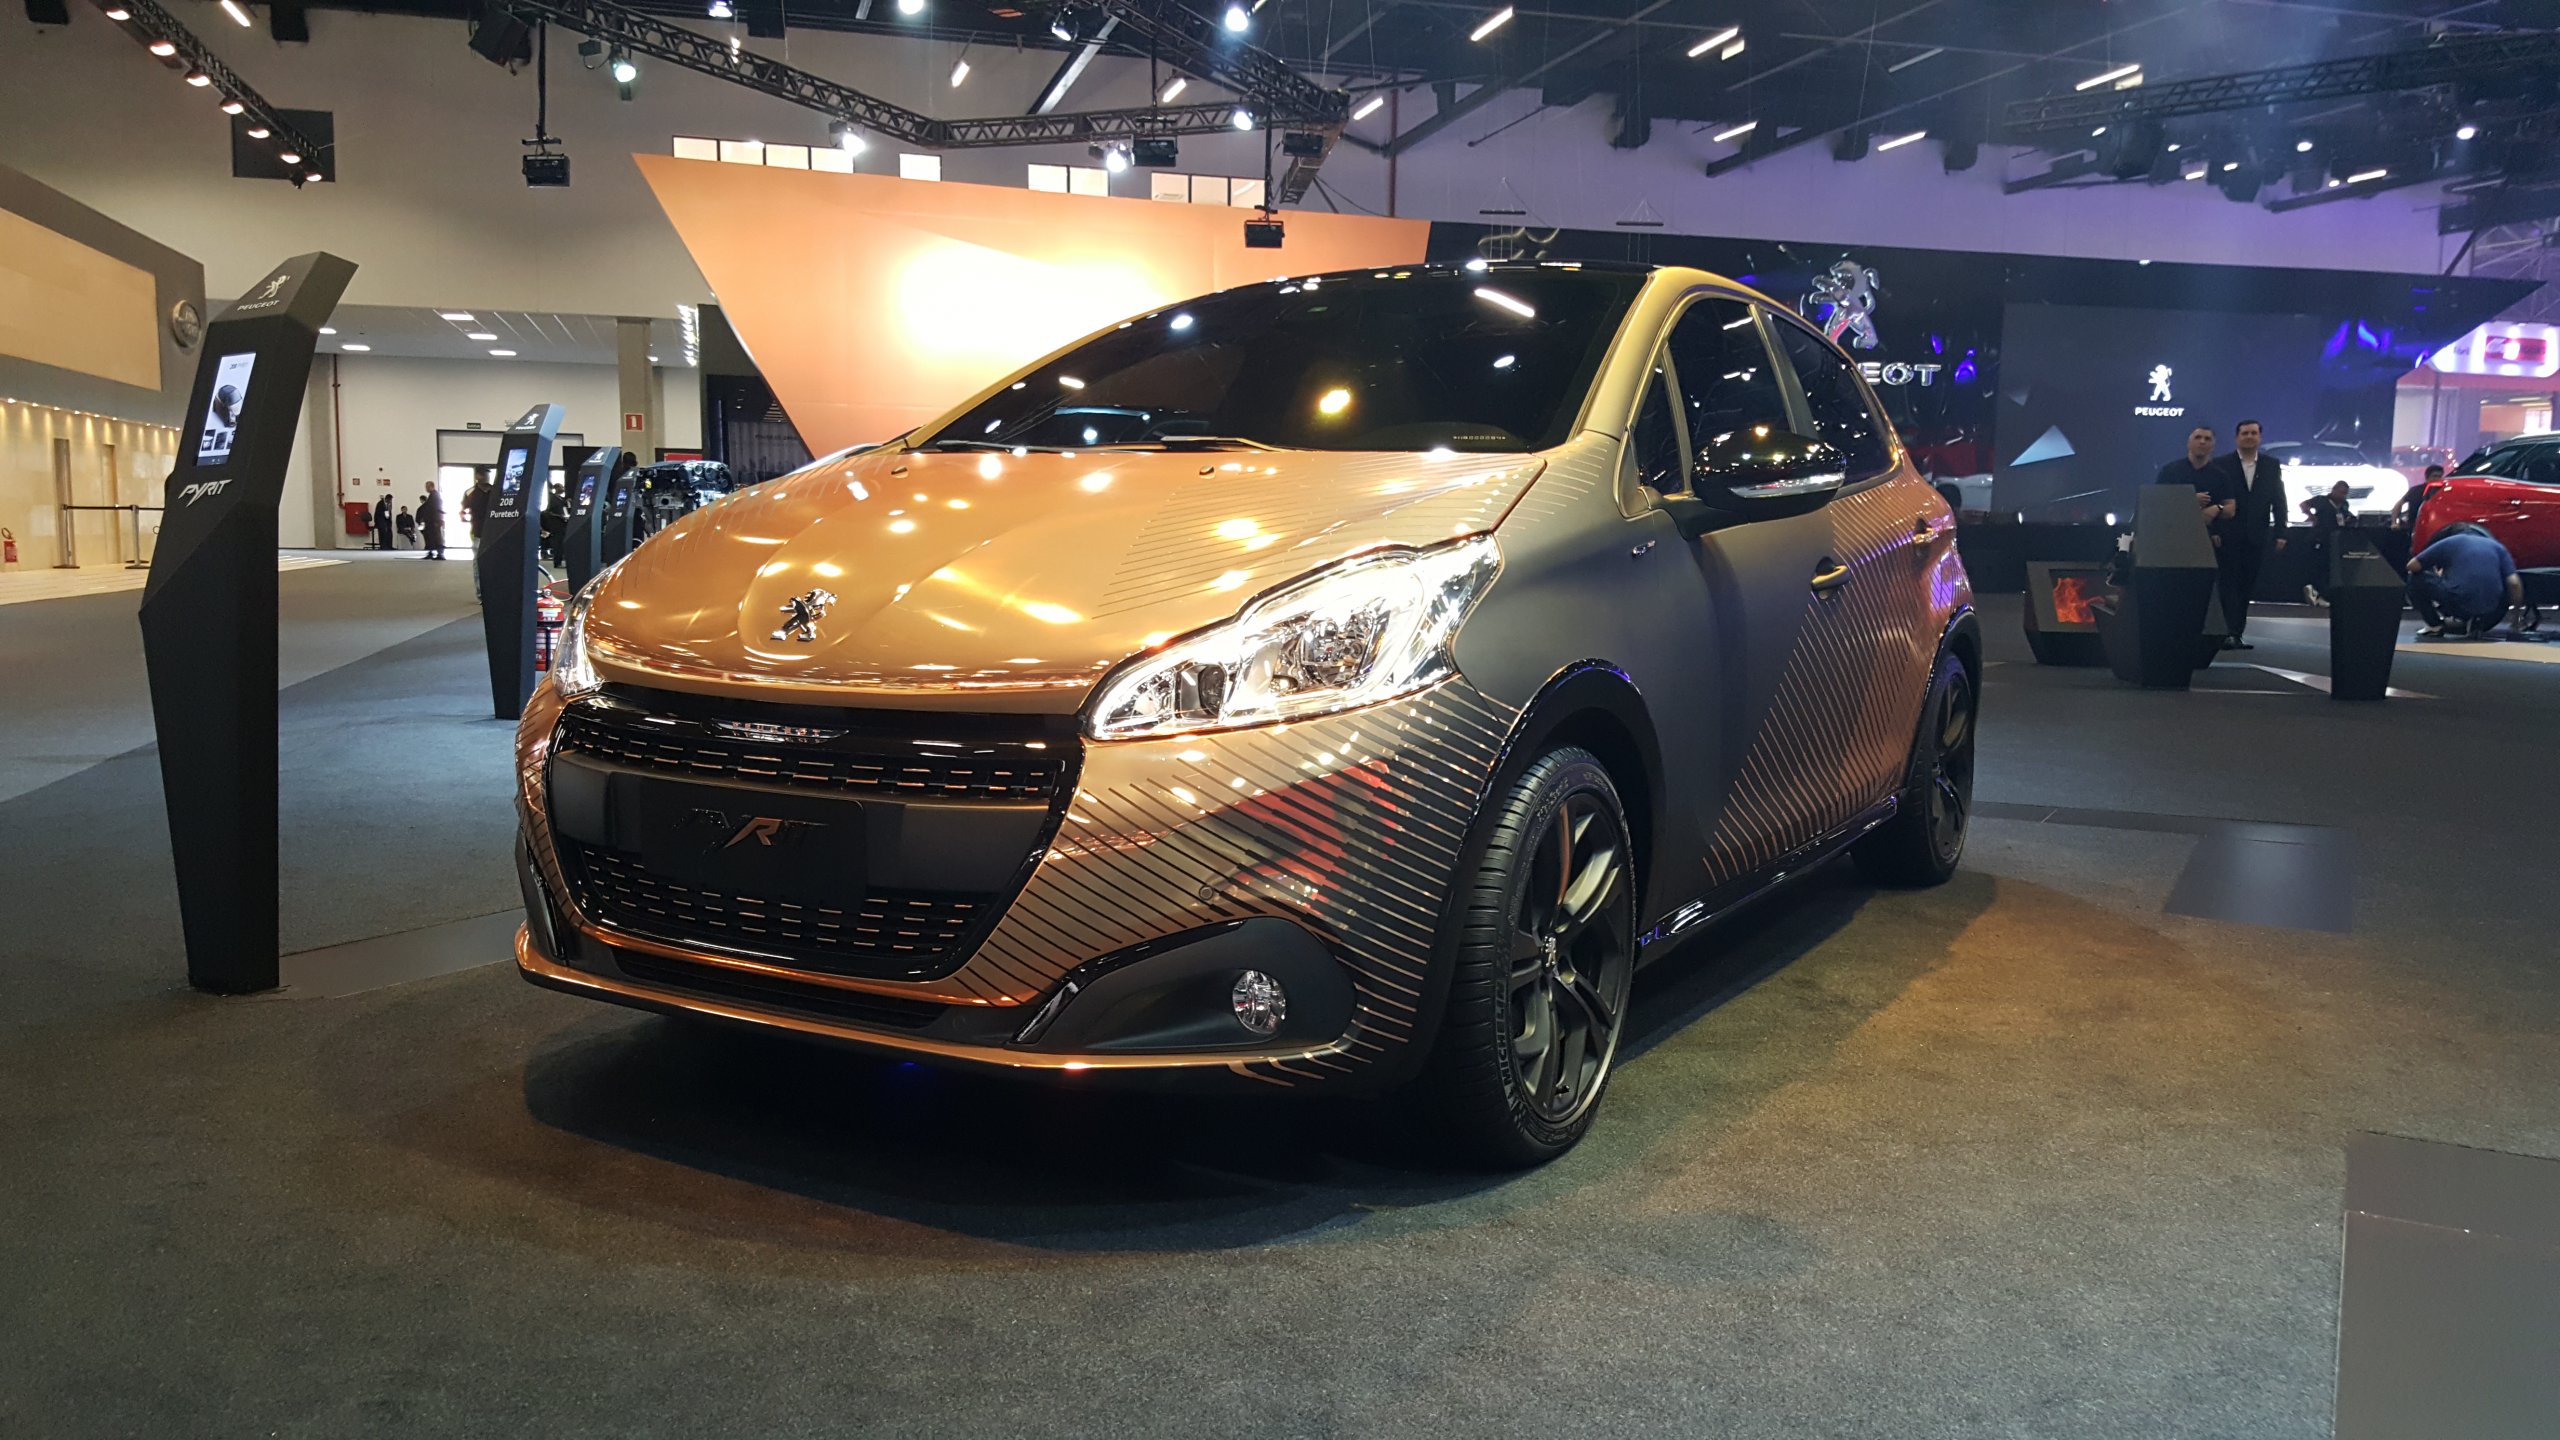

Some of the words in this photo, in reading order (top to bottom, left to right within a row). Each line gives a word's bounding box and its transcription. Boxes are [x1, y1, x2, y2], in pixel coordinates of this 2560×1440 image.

[237, 299, 280, 312] PEUGEOT
[2135, 406, 2185, 417] PEUGEOT
[178, 478, 233, 508] PYRIT
[499, 497, 514, 507] 208
[489, 509, 520, 519] Puretech
[1495, 980, 1513, 1086] MICHELIN
